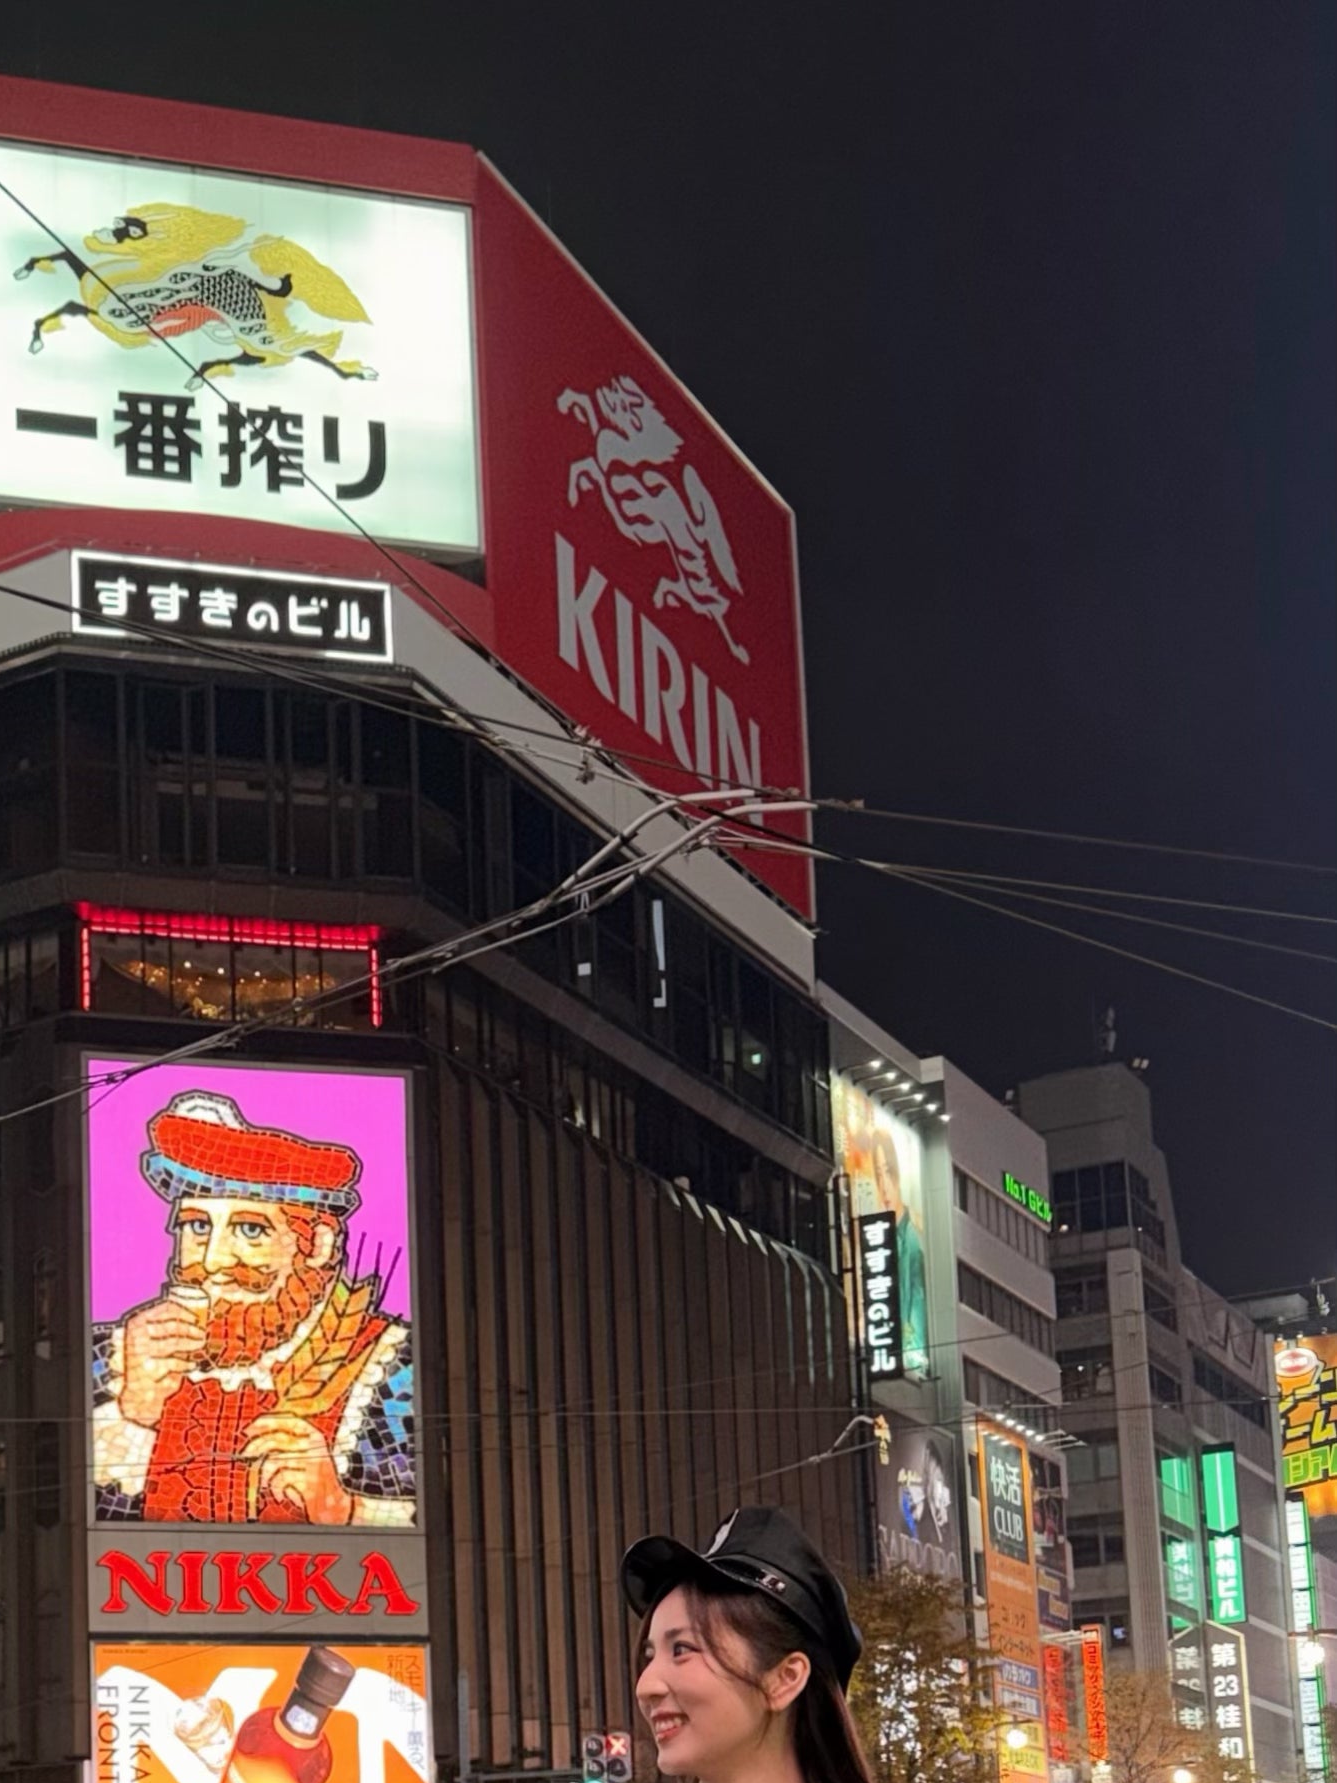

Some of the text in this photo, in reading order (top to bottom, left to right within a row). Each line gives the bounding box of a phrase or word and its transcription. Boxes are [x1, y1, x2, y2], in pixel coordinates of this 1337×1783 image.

[15, 390, 388, 502] 一番搾り
[93, 575, 374, 643] すすきのビル
[554, 530, 762, 829] KIRIN
[993, 1504, 1024, 1542] CLUB
[95, 1549, 422, 1617] NIKKA
[127, 1684, 152, 1783] NIKKA
